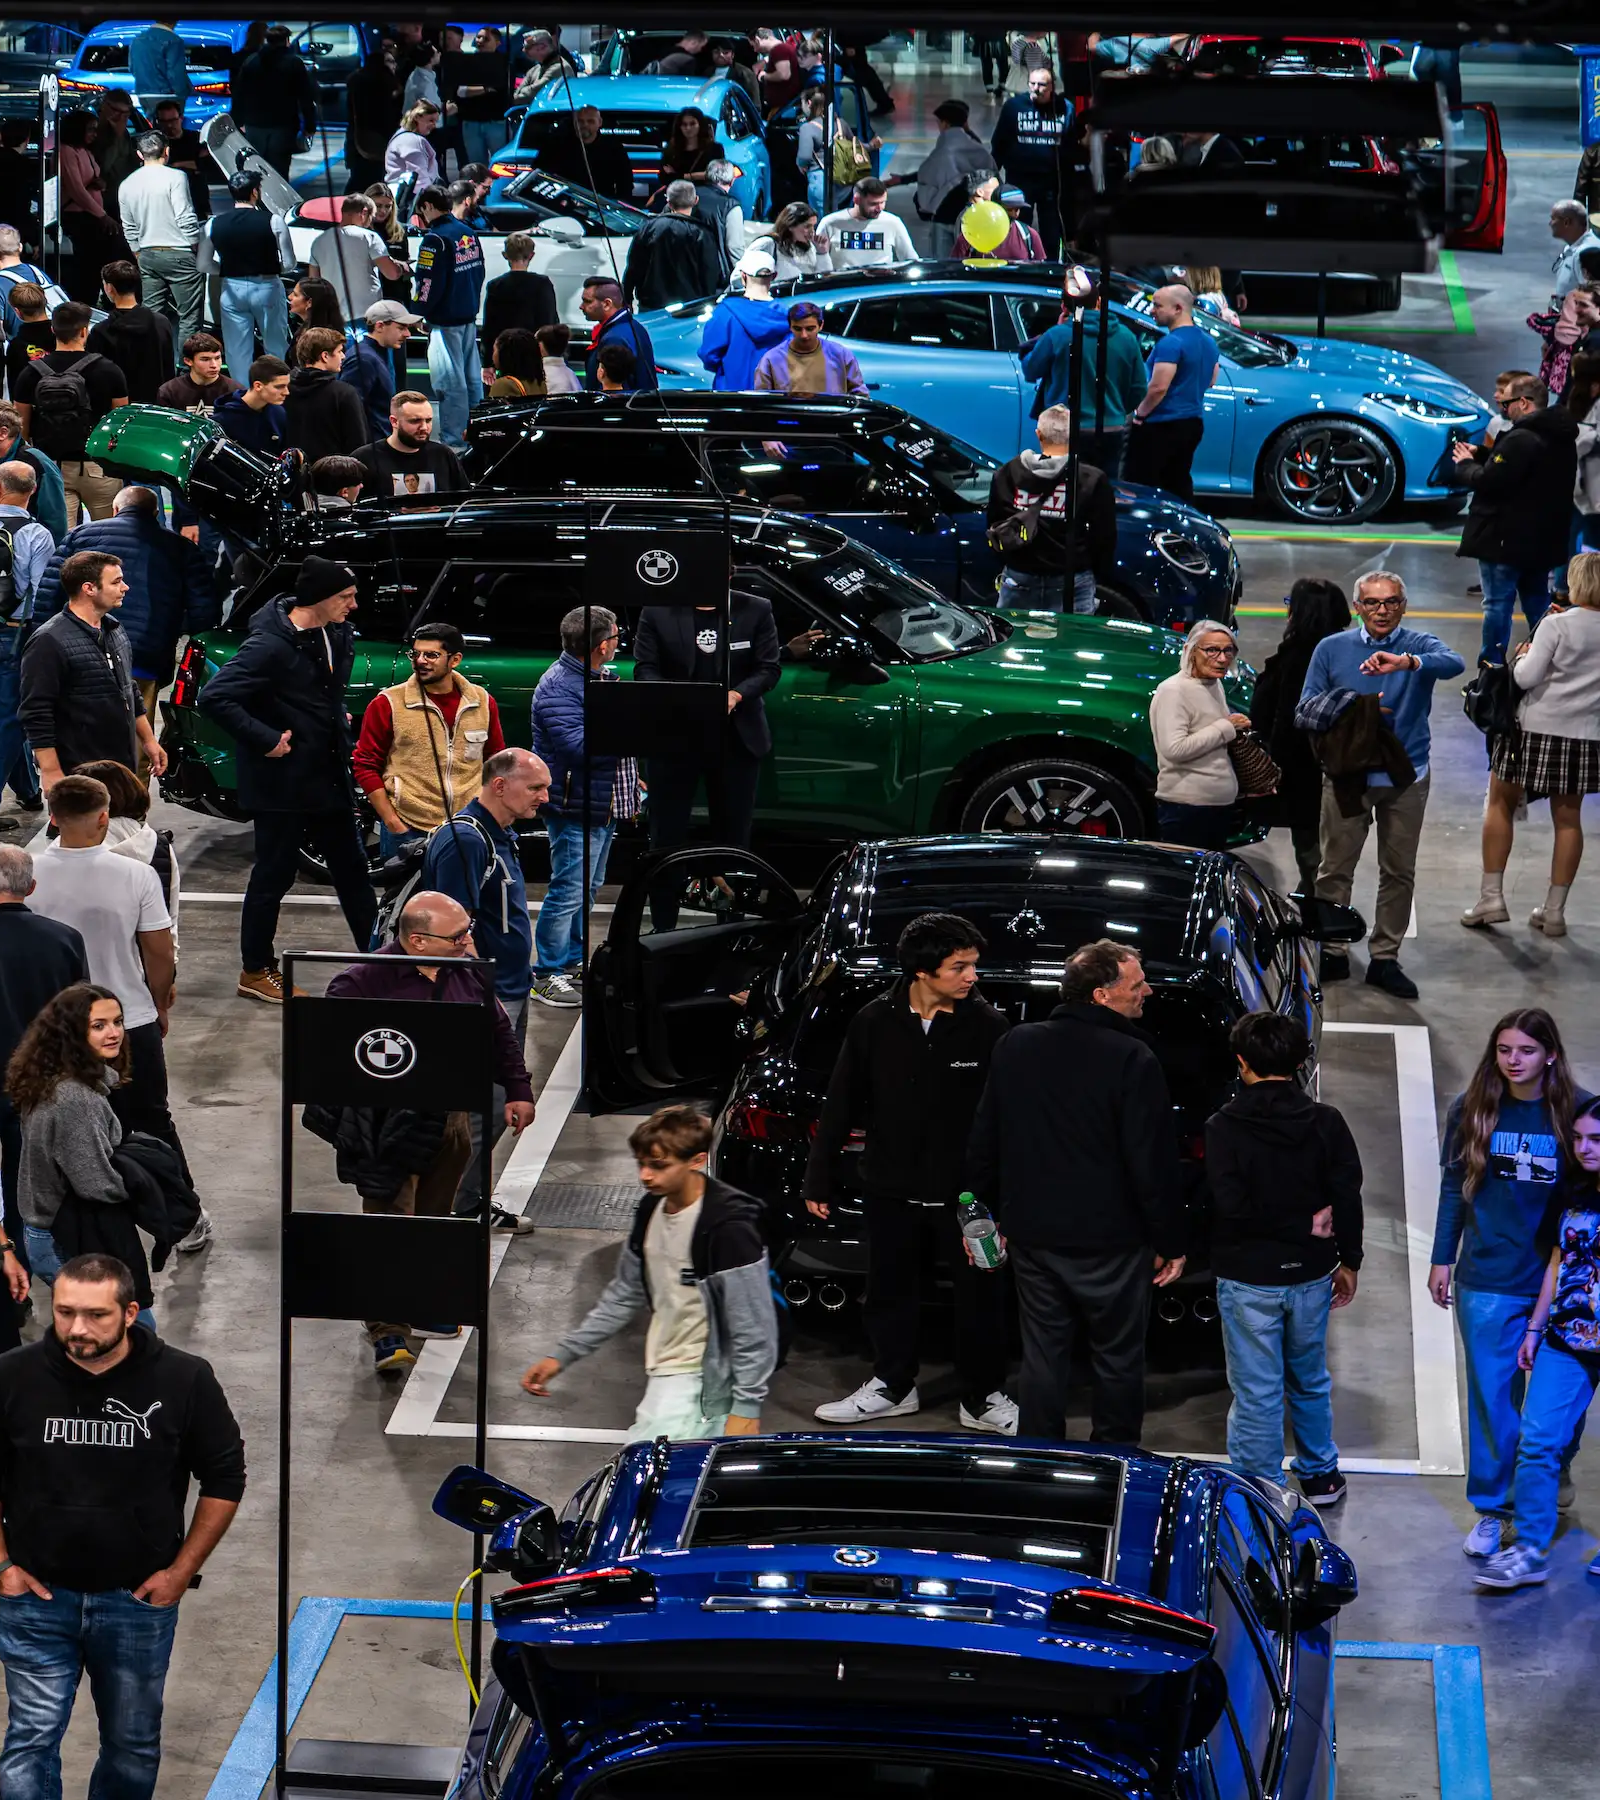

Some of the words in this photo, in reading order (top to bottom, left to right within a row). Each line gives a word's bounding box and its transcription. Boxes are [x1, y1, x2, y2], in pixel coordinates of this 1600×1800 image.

[1018, 120, 1039, 131] CAMP
[642, 552, 673, 562] BMW
[363, 1031, 407, 1046] BMW
[44, 1418, 134, 1447] PUMA
